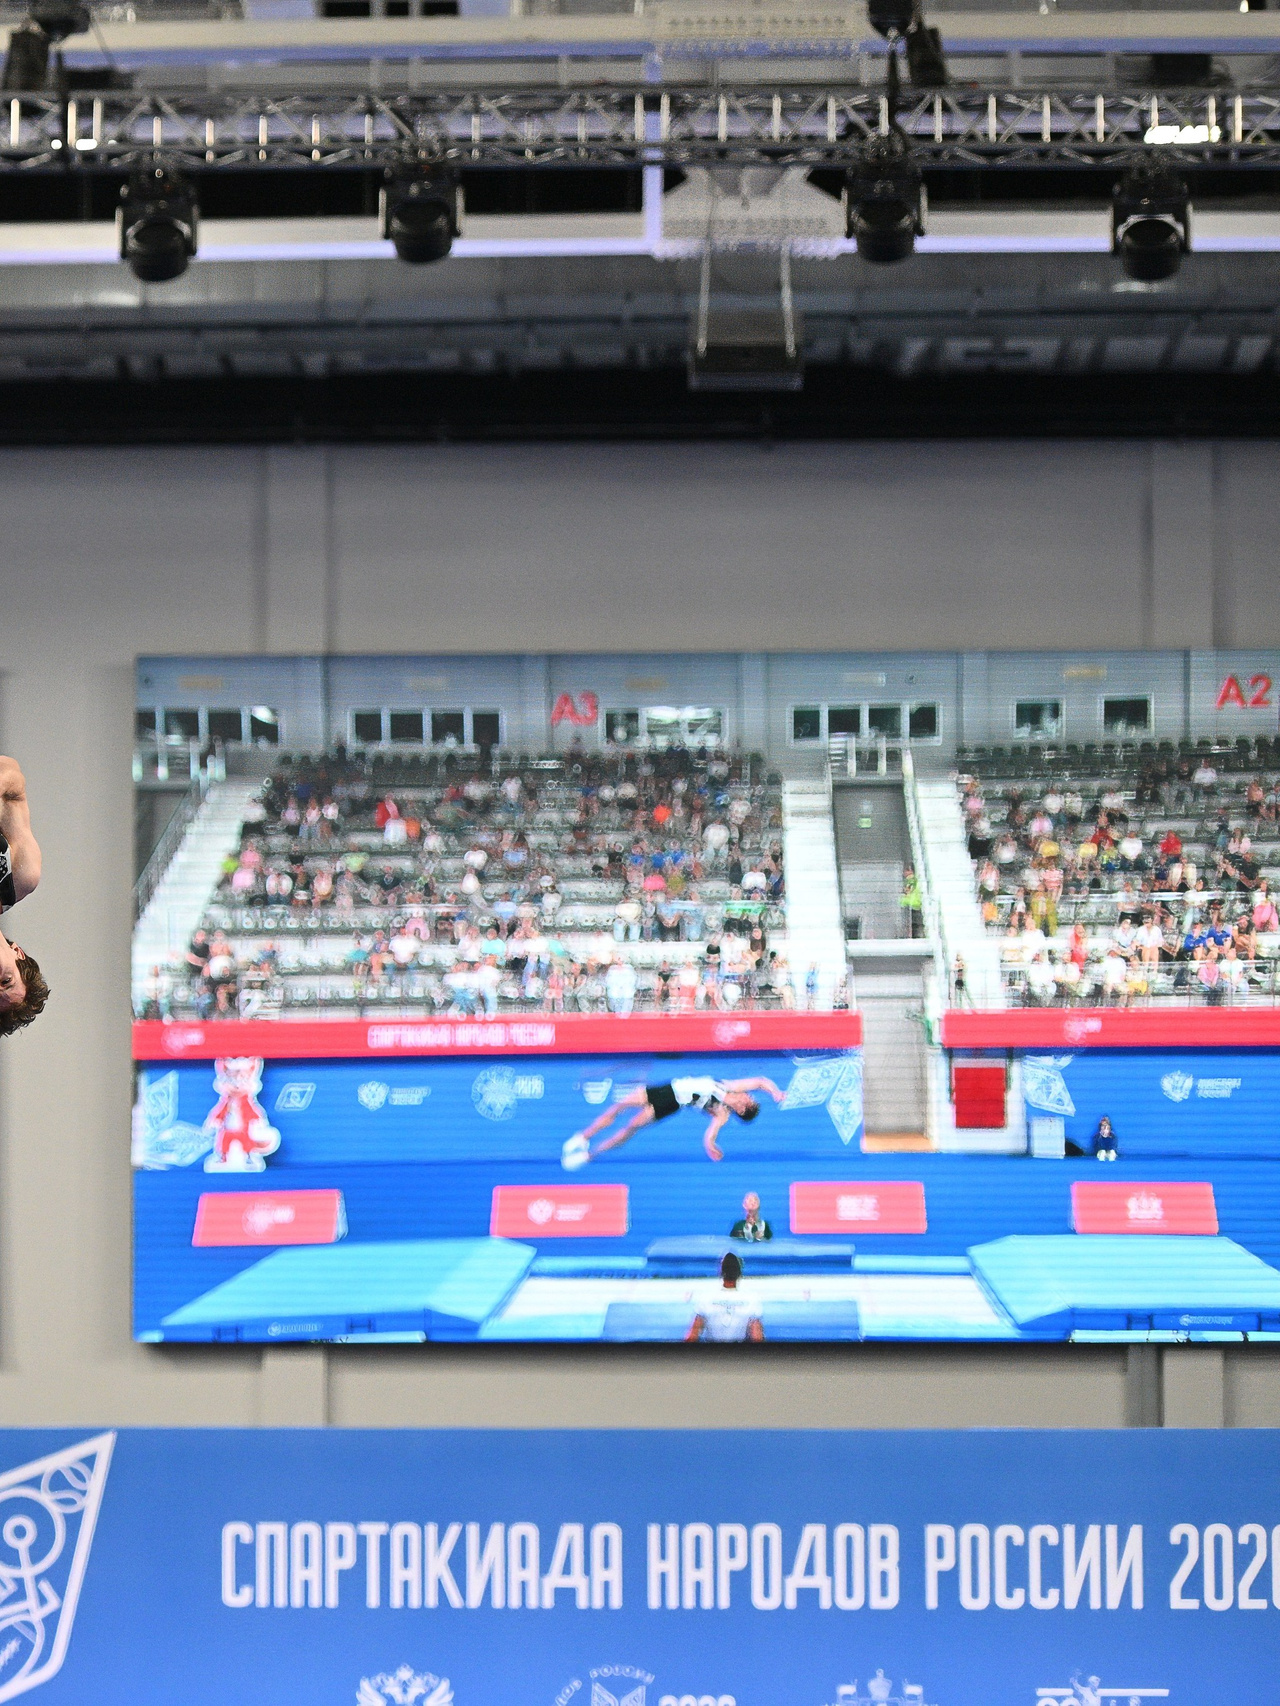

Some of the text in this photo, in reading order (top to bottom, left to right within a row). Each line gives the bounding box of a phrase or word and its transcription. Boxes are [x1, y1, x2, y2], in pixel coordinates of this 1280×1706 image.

[221, 1522, 1280, 1611] СПАРТАКИАДА НАРОДОВ РОССИИ 202
